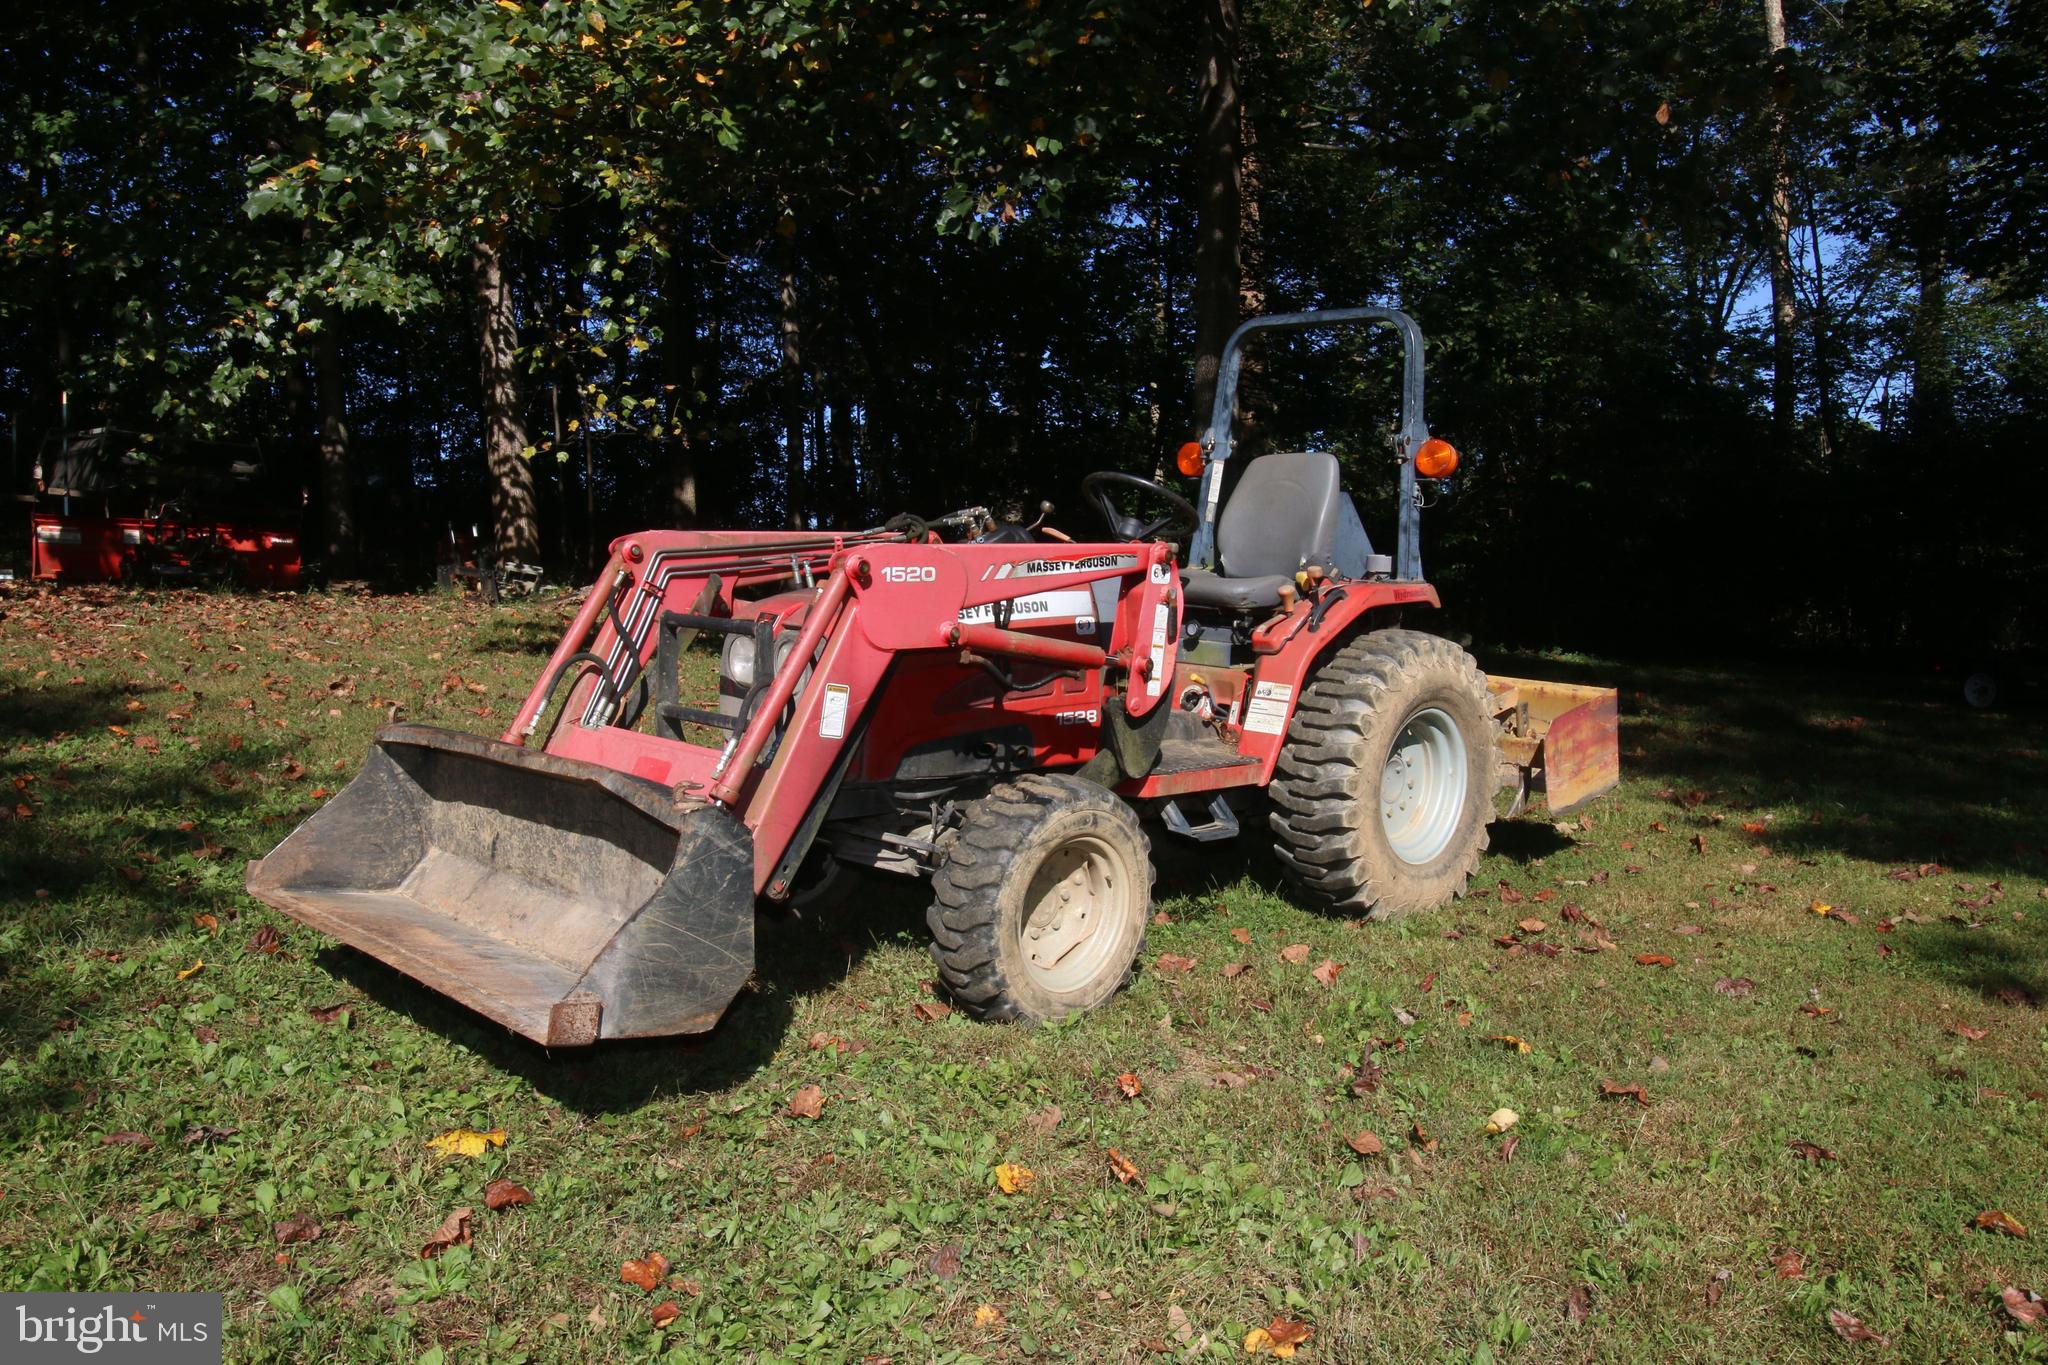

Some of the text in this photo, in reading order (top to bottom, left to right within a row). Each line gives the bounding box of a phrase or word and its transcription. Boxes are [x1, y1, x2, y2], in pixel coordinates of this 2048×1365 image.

[881, 566, 936, 582] 1520
[1027, 561, 1068, 573] MASSEY
[1056, 709, 1097, 725] 1528
